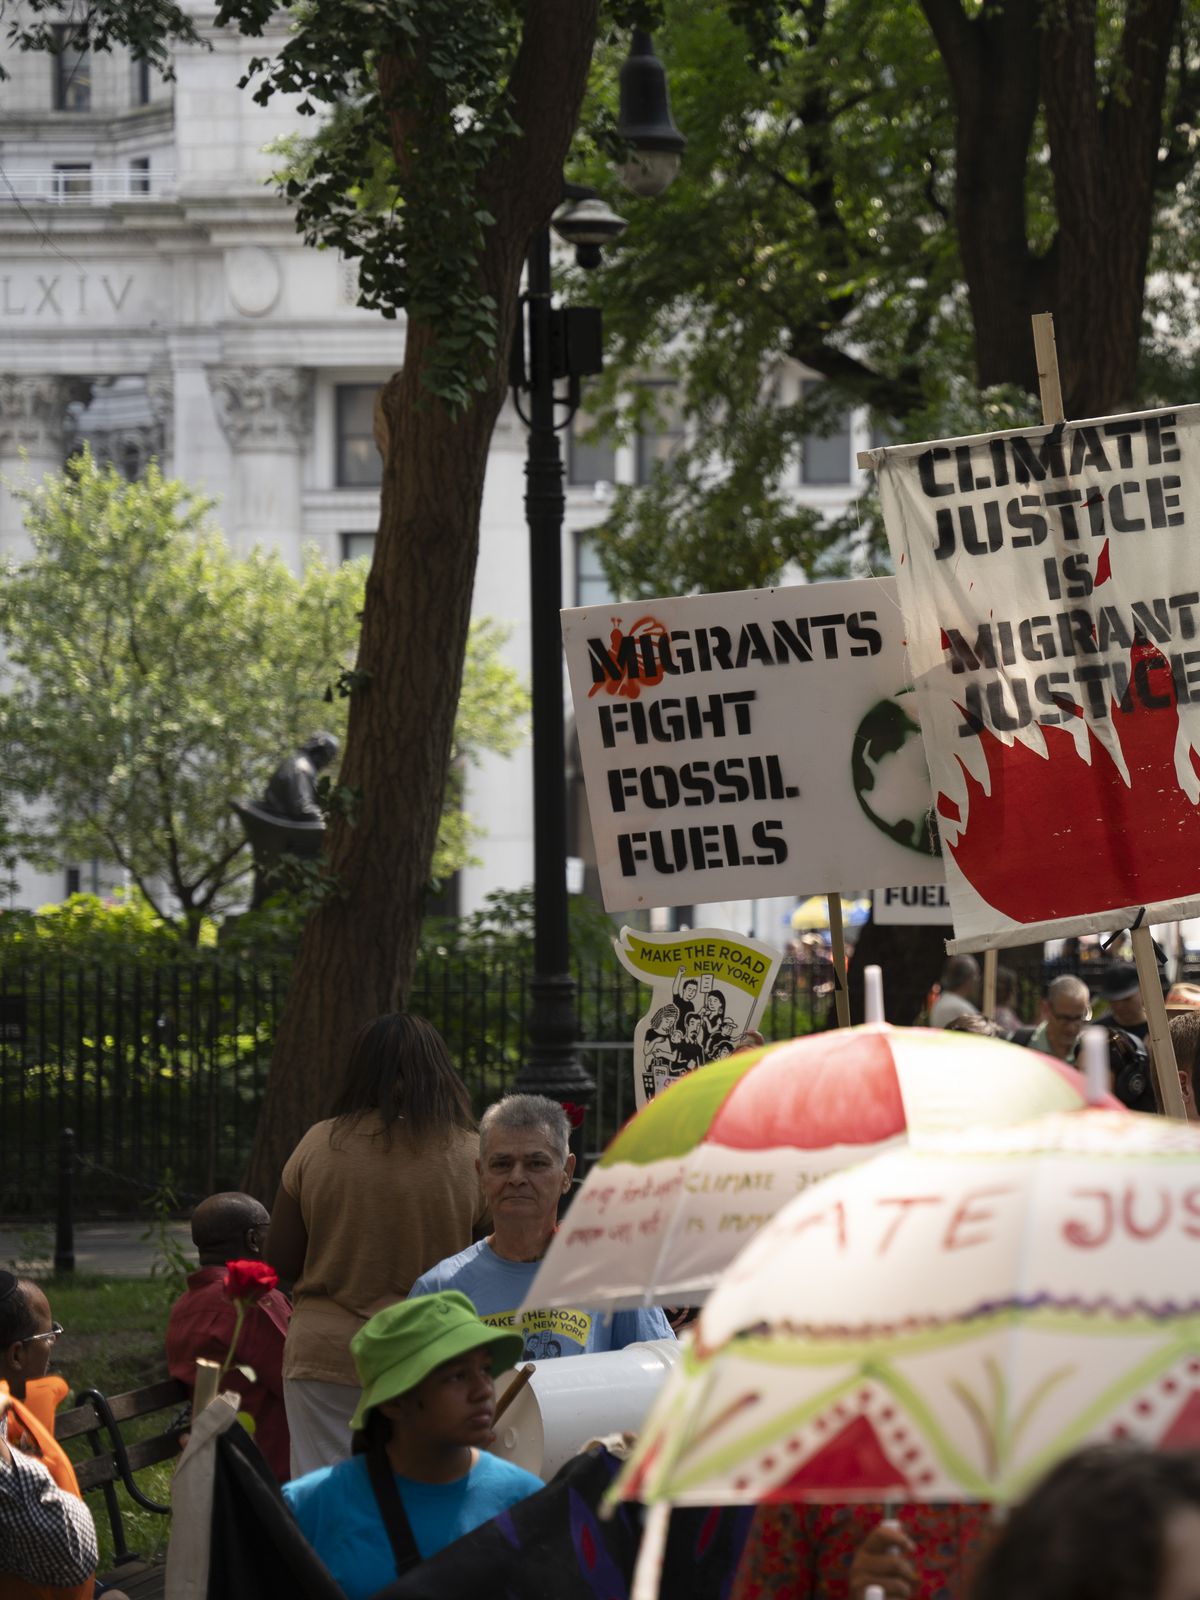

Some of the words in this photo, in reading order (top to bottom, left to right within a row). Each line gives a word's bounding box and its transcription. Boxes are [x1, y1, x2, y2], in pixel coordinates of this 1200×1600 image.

[918, 414, 1181, 498] CLIMATE
[934, 475, 1185, 561] JUSTICE
[1043, 553, 1094, 601] IS
[587, 611, 883, 683] MIGRANTS
[946, 591, 1200, 675] MIGRANT
[598, 690, 757, 749] FIGHT
[607, 754, 800, 813] FOSSIL
[617, 820, 789, 877] FUELS
[884, 886, 950, 907] FUEL
[639, 947, 683, 963] MAKE
[684, 944, 716, 959] THE
[718, 947, 766, 974] ROAD
[693, 960, 724, 973] NEW
[727, 966, 760, 989] YORK
[533, 1319, 558, 1331] NEW
[560, 1320, 585, 1340] YORK
[549, 1308, 588, 1330] ROAD
